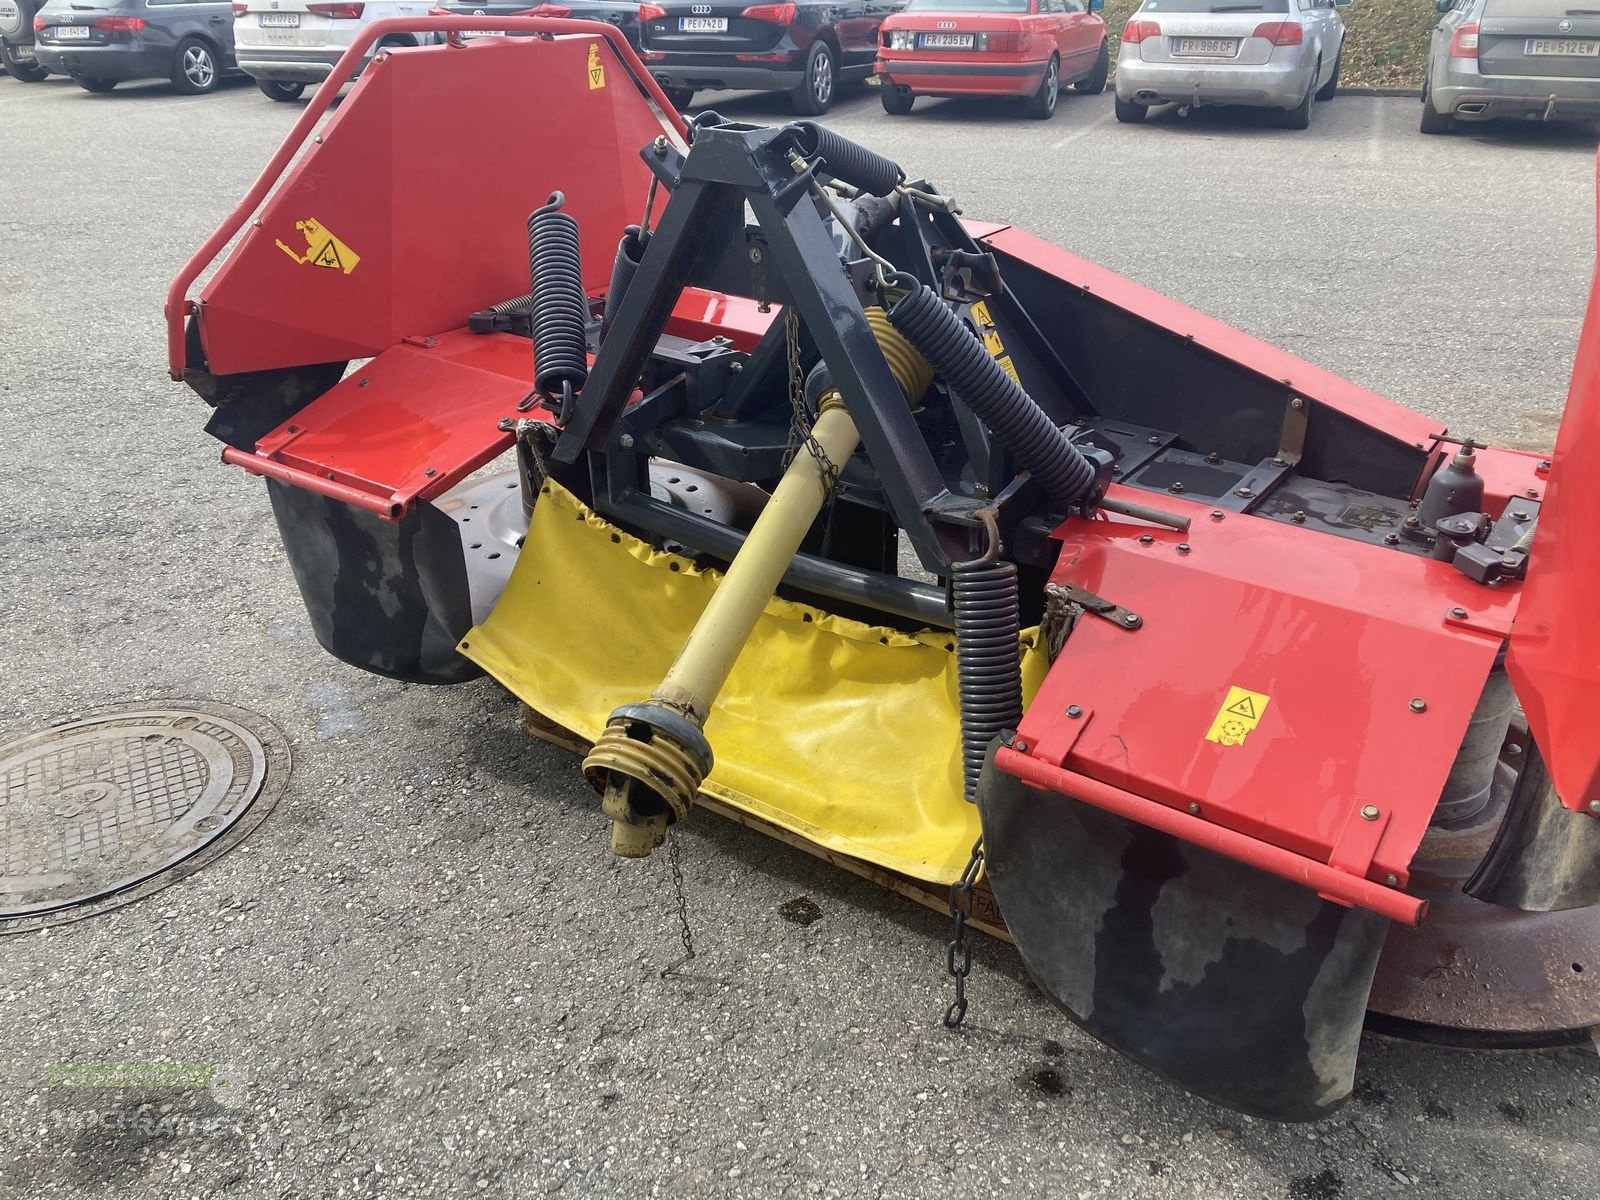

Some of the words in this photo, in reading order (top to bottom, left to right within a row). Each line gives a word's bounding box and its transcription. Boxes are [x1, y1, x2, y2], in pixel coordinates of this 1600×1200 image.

[687, 19, 697, 29] PE
[926, 35, 937, 45] FR
[1182, 40, 1194, 51] FR
[1535, 41, 1550, 52] PE
